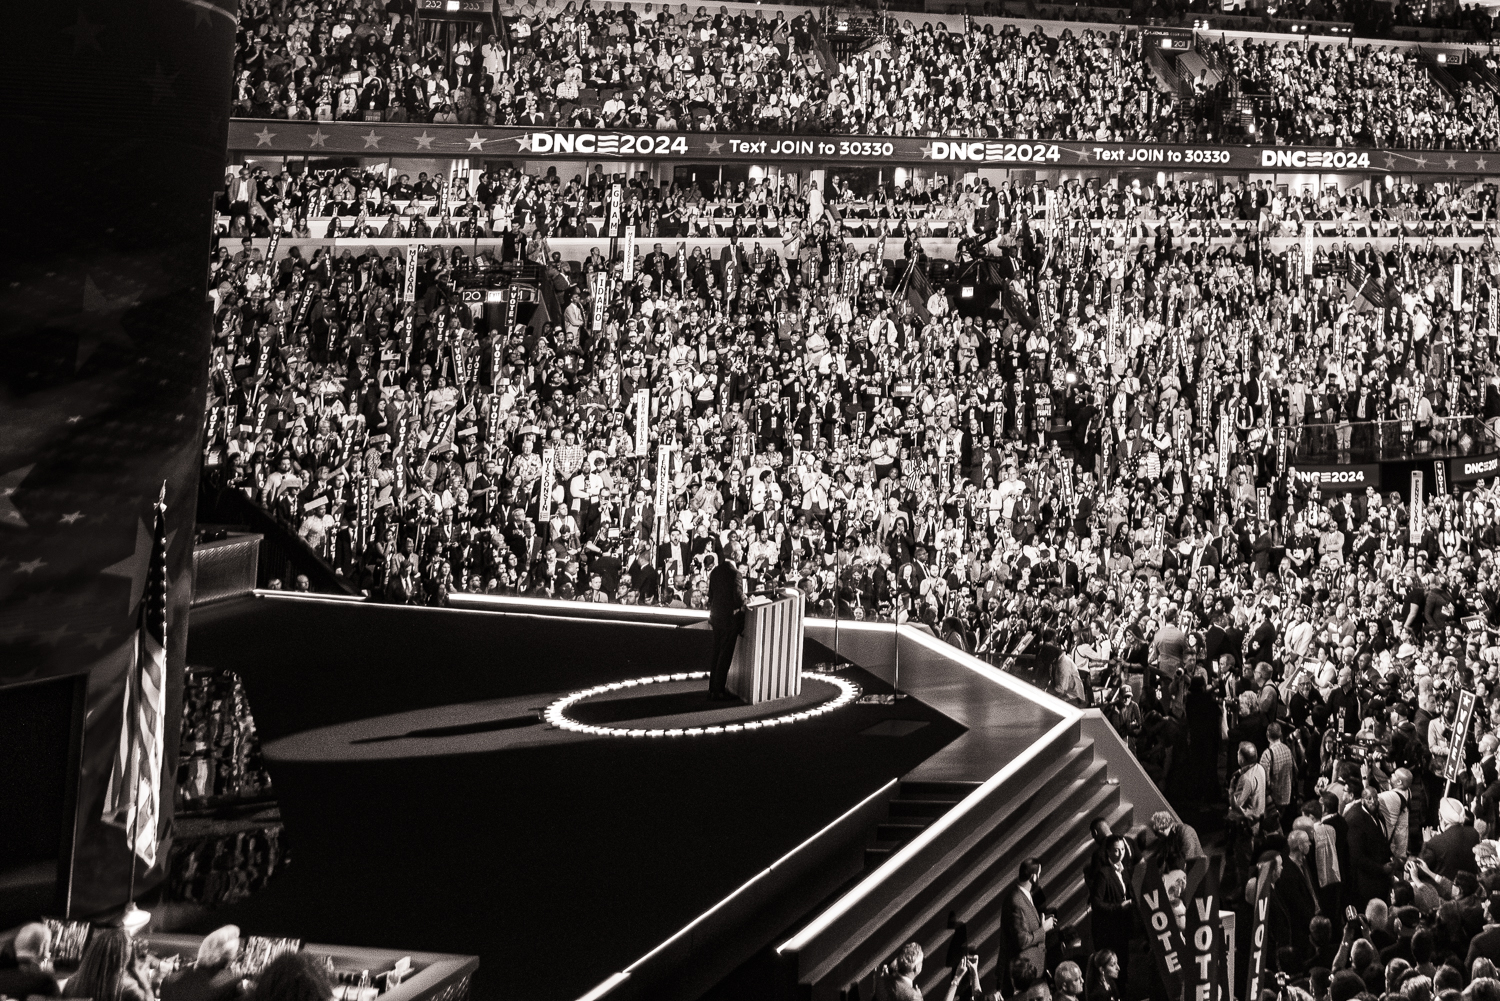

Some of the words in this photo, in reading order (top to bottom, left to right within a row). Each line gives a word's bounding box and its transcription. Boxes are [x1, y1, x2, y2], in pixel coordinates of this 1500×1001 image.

[425, 0, 442, 9] 232
[729, 140, 767, 153] Text
[771, 141, 813, 154] JOIN
[819, 142, 835, 154] to
[840, 142, 893, 155] 30330
[1093, 148, 1125, 160] Text
[1128, 149, 1163, 161] JOIN
[1167, 150, 1181, 162] to
[1185, 150, 1230, 163] 30330
[611, 190, 620, 230] GUAM
[408, 249, 416, 294] MICHIGAN
[463, 291, 481, 300] 120
[507, 292, 518, 317] VOTE
[595, 279, 604, 323] IDAHO
[405, 316, 413, 344] VOTE
[494, 343, 502, 372] VOTE
[432, 414, 450, 443] VOTE
[542, 457, 552, 512] WISCONSIN
[360, 487, 369, 516] VOTE
[1451, 710, 1469, 761] VOTE
[1144, 888, 1182, 973] VOTE
[1250, 896, 1269, 1001] VOTE
